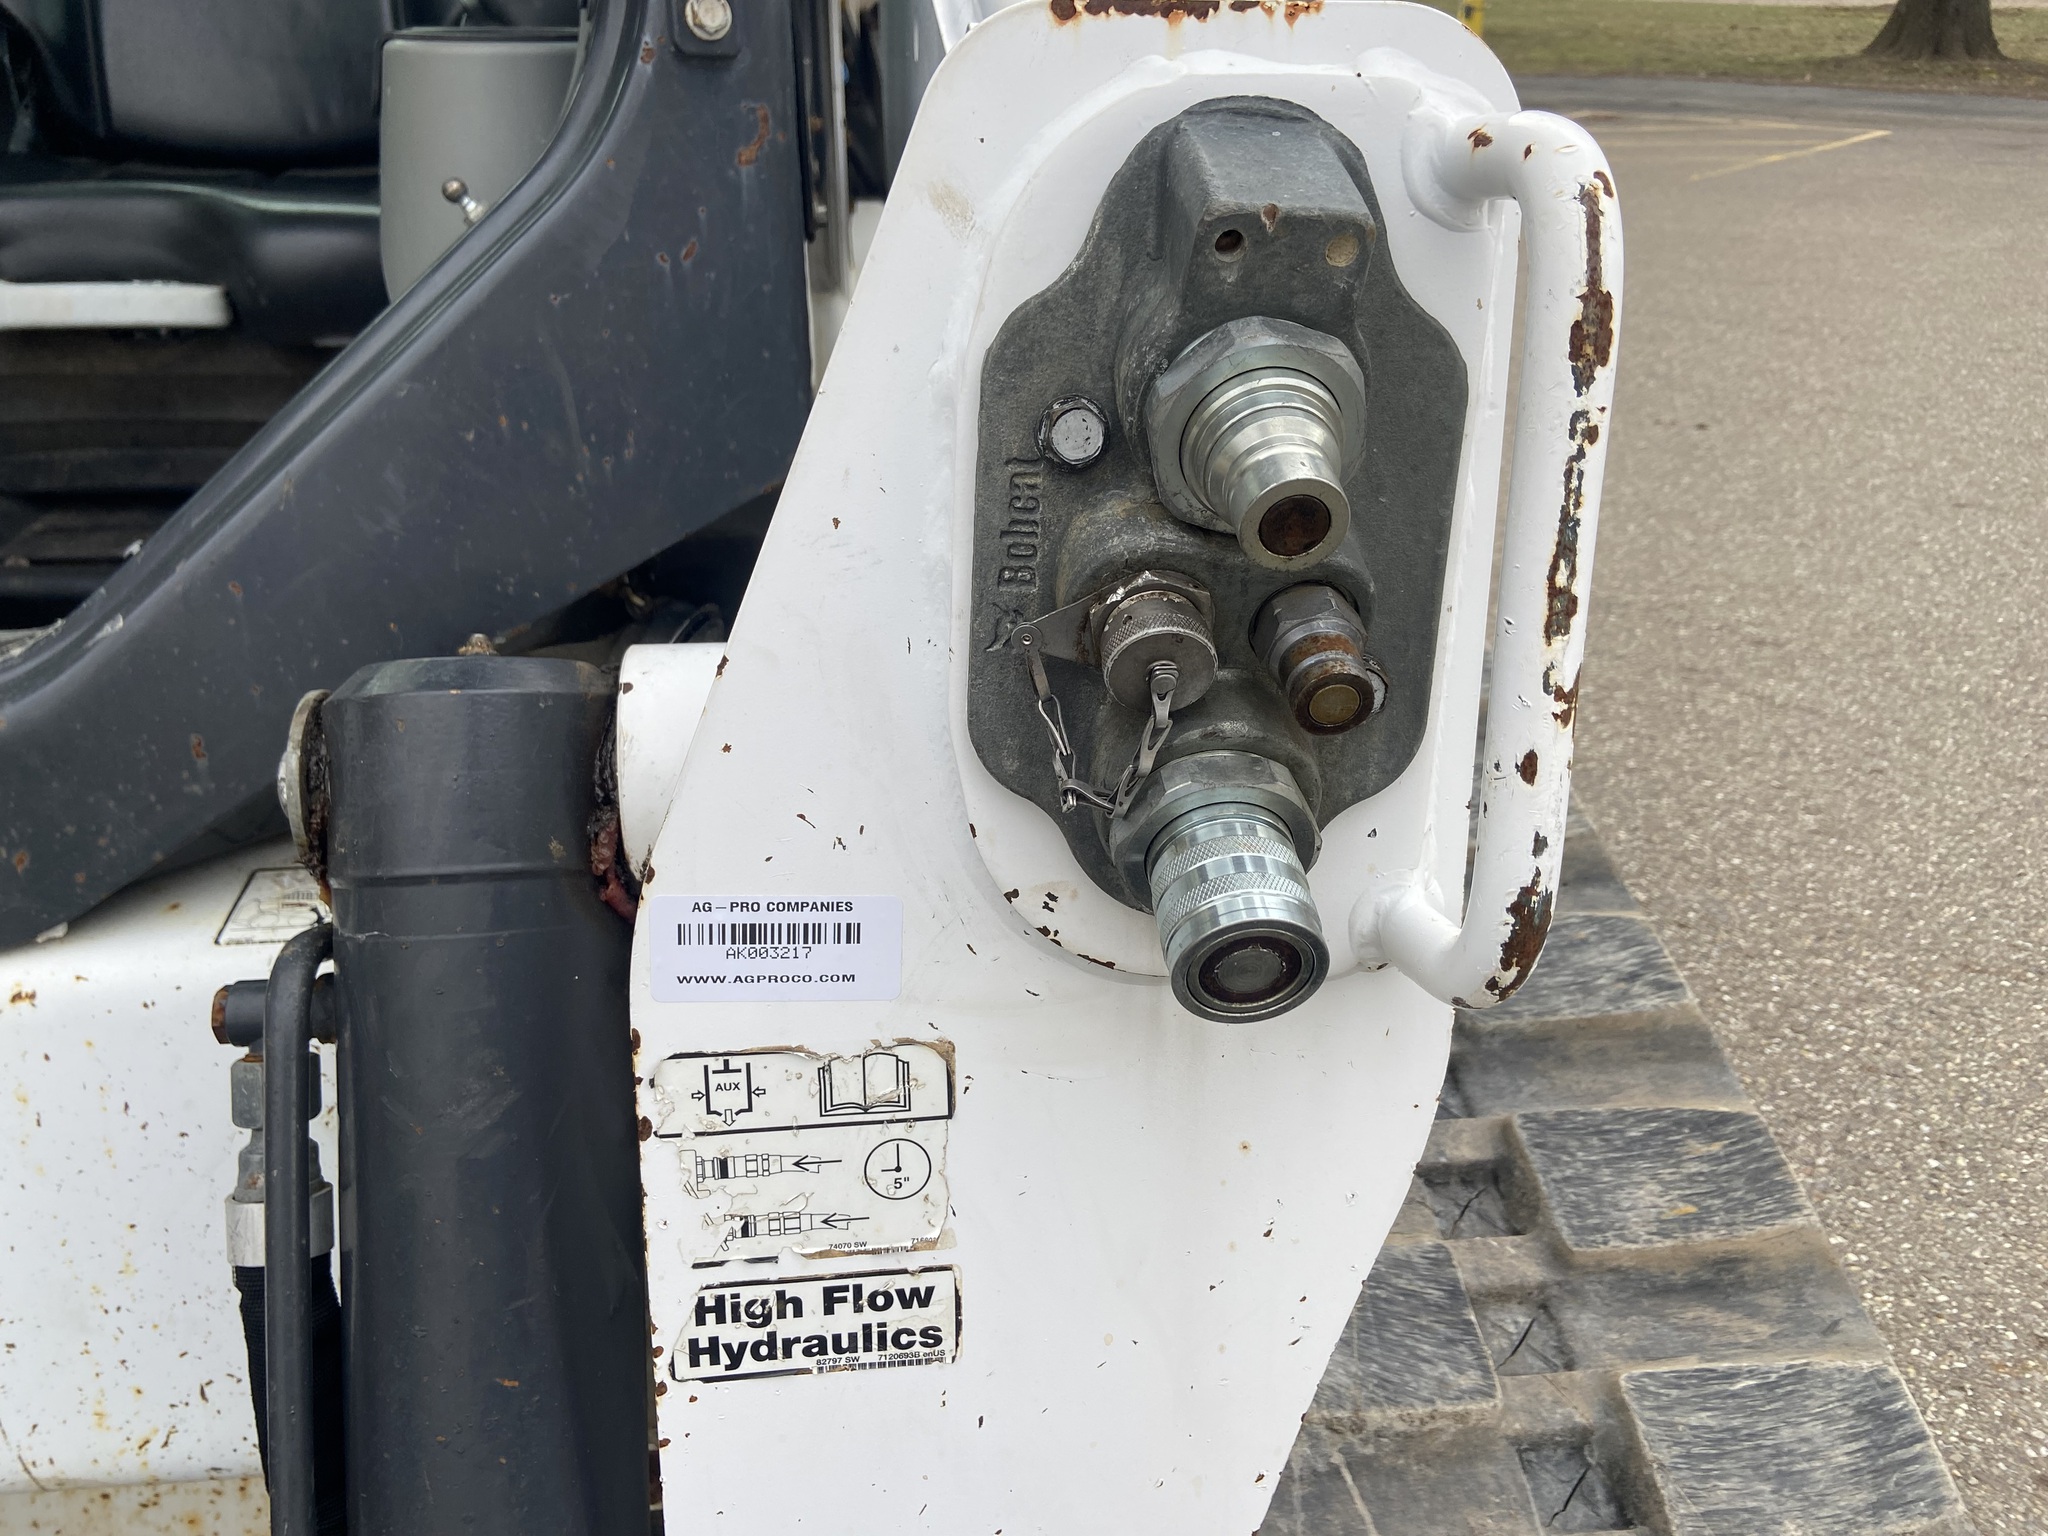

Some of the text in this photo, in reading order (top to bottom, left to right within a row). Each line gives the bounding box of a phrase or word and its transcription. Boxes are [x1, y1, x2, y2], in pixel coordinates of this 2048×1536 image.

[998, 457, 1043, 592] Bobcat
[766, 901, 854, 912] COMPANIES
[726, 947, 812, 960] AK003217
[677, 974, 856, 984] WWW.AGPROCO.COM
[715, 1082, 741, 1092] AUX
[828, 1242, 852, 1250] 74070
[695, 1283, 936, 1328] High Flow
[688, 1321, 944, 1371] Hydraulics
[816, 1357, 842, 1366] 82797
[845, 1356, 860, 1364] SW
[922, 1349, 946, 1358] enUS
